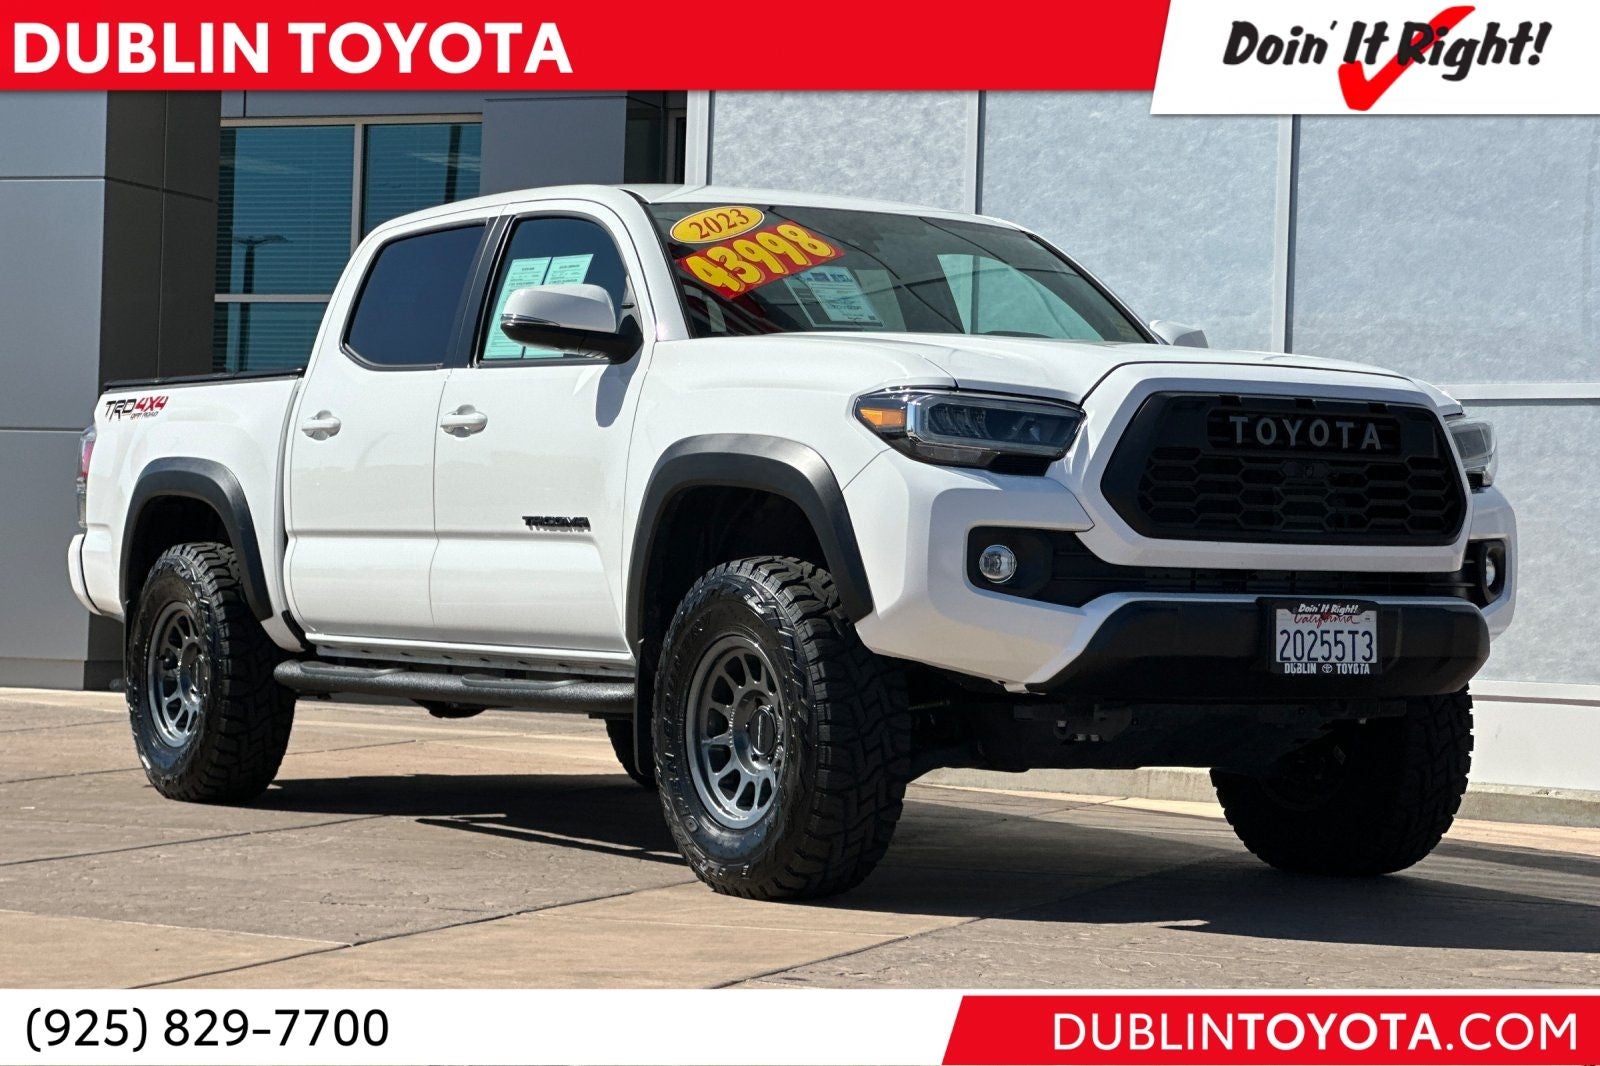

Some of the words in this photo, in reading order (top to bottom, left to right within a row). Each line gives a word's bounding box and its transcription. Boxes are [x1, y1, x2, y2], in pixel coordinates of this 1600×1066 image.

[689, 209, 749, 239] 2023
[685, 224, 836, 292] 43998
[1229, 415, 1382, 450] TOYOTA
[1280, 629, 1373, 661] 20255T3
[1284, 663, 1317, 674] DUBLIN
[1336, 663, 1370, 675] TOYOTA
